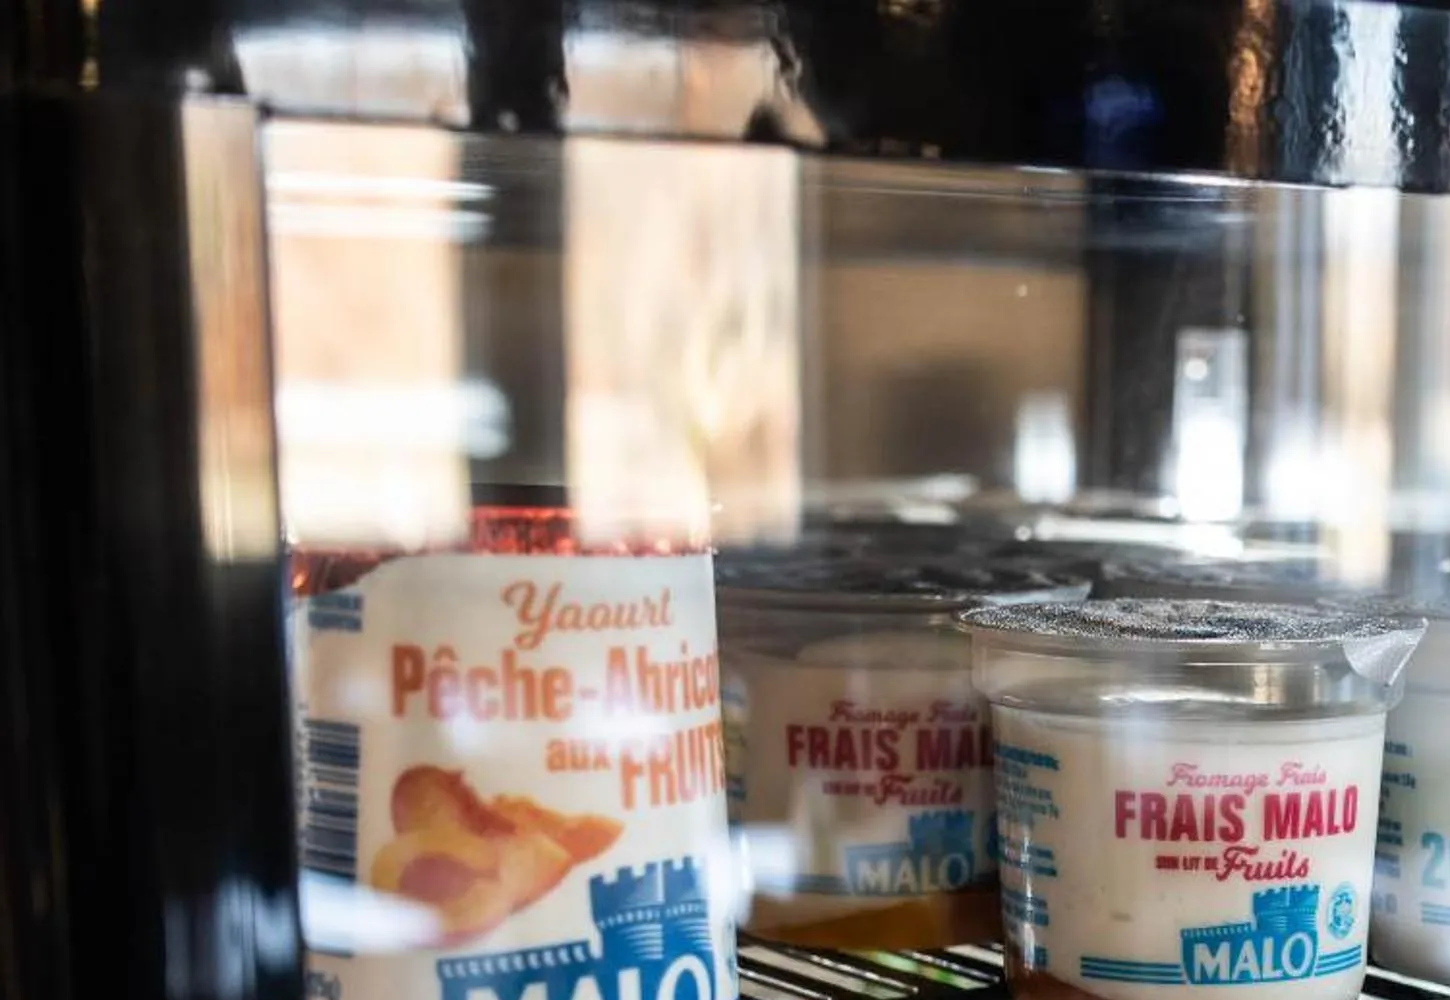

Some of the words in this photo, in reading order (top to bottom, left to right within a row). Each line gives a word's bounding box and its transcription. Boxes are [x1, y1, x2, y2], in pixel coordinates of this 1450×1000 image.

[502, 580, 676, 651] Yaourt
[390, 642, 720, 721] Pêche-Abrico
[545, 730, 613, 773] aux
[785, 724, 900, 771] FRAIS
[914, 724, 995, 771] MAL
[1166, 762, 1269, 795] Fromage
[1275, 760, 1327, 787] Frais
[1114, 789, 1246, 842] FRAIS
[1262, 784, 1359, 842] MALO
[856, 852, 969, 893] MALO
[1215, 845, 1310, 882] Fruits
[1192, 931, 1314, 983] MALO
